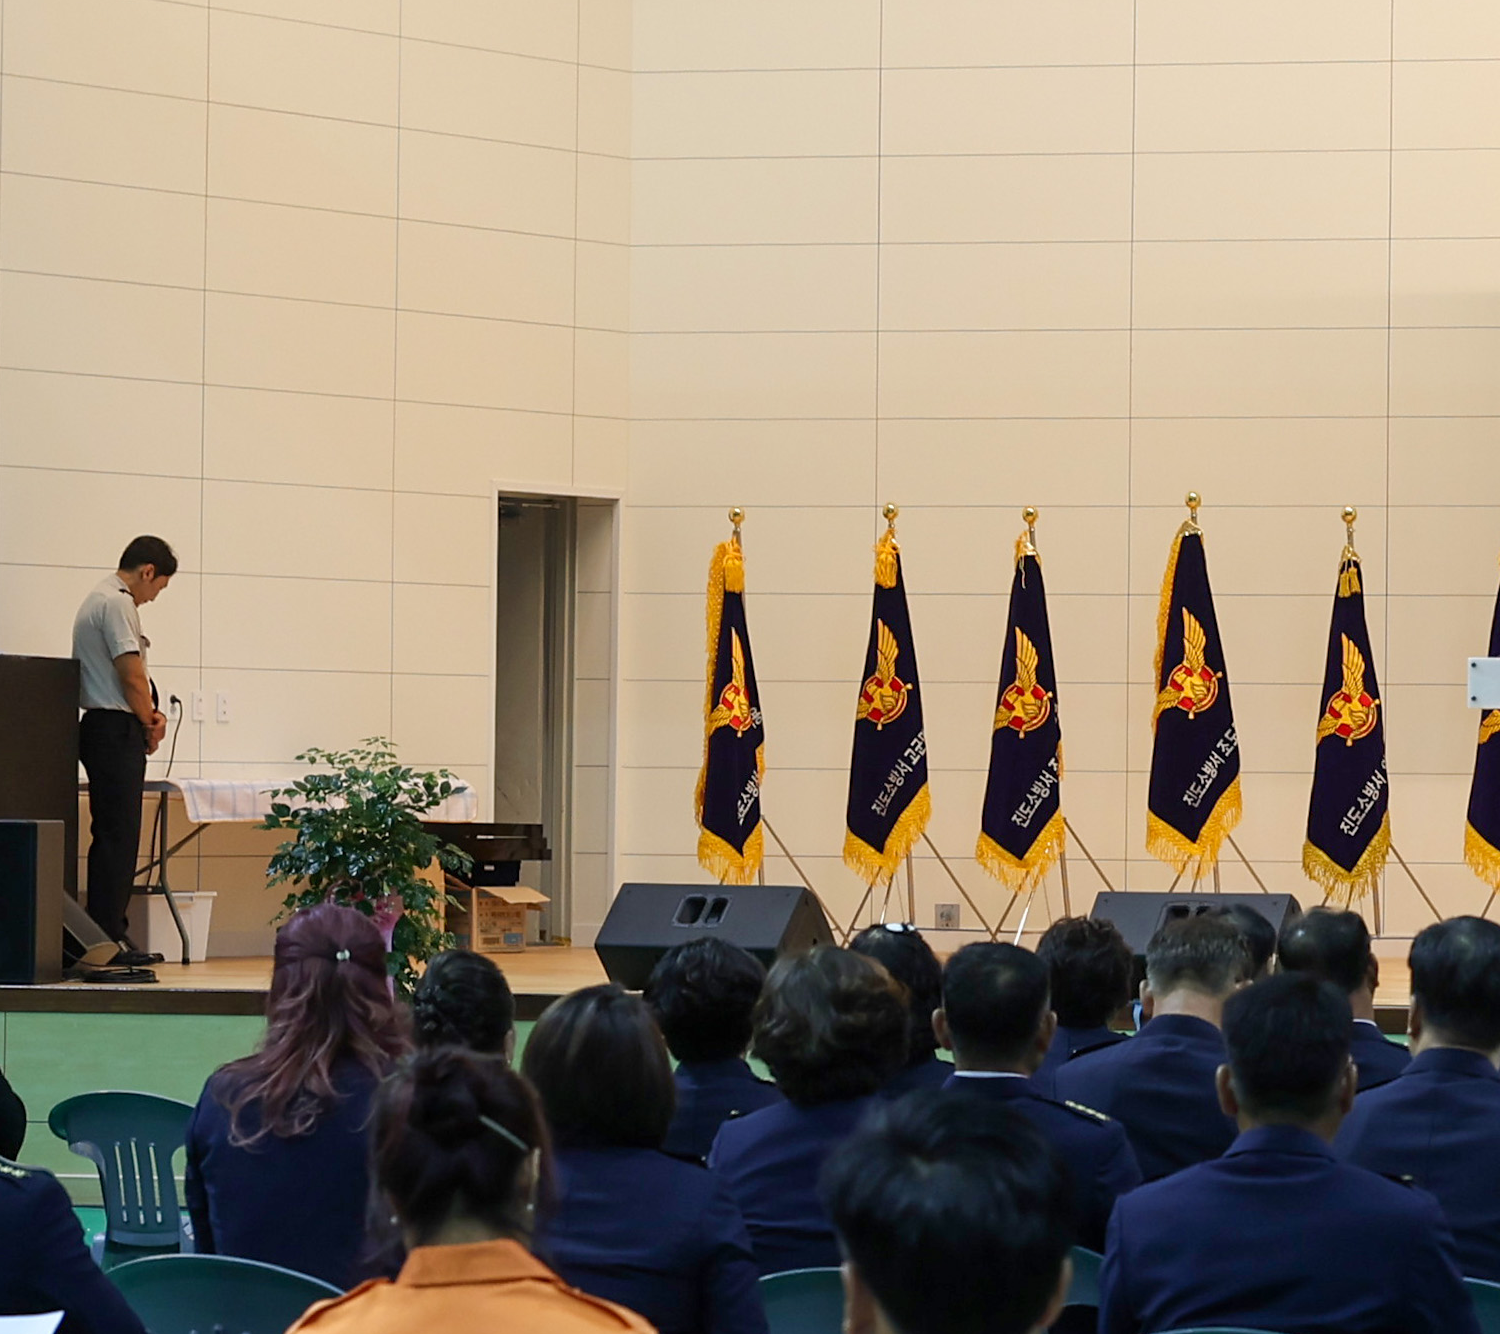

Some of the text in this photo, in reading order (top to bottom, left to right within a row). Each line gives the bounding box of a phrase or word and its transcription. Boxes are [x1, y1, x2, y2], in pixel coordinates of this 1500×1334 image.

[871, 759, 913, 817] 진도소방서
[1011, 769, 1058, 828] 진도소방서
[1183, 750, 1226, 808] 진도소방서
[1340, 769, 1387, 836] 진도소방서
